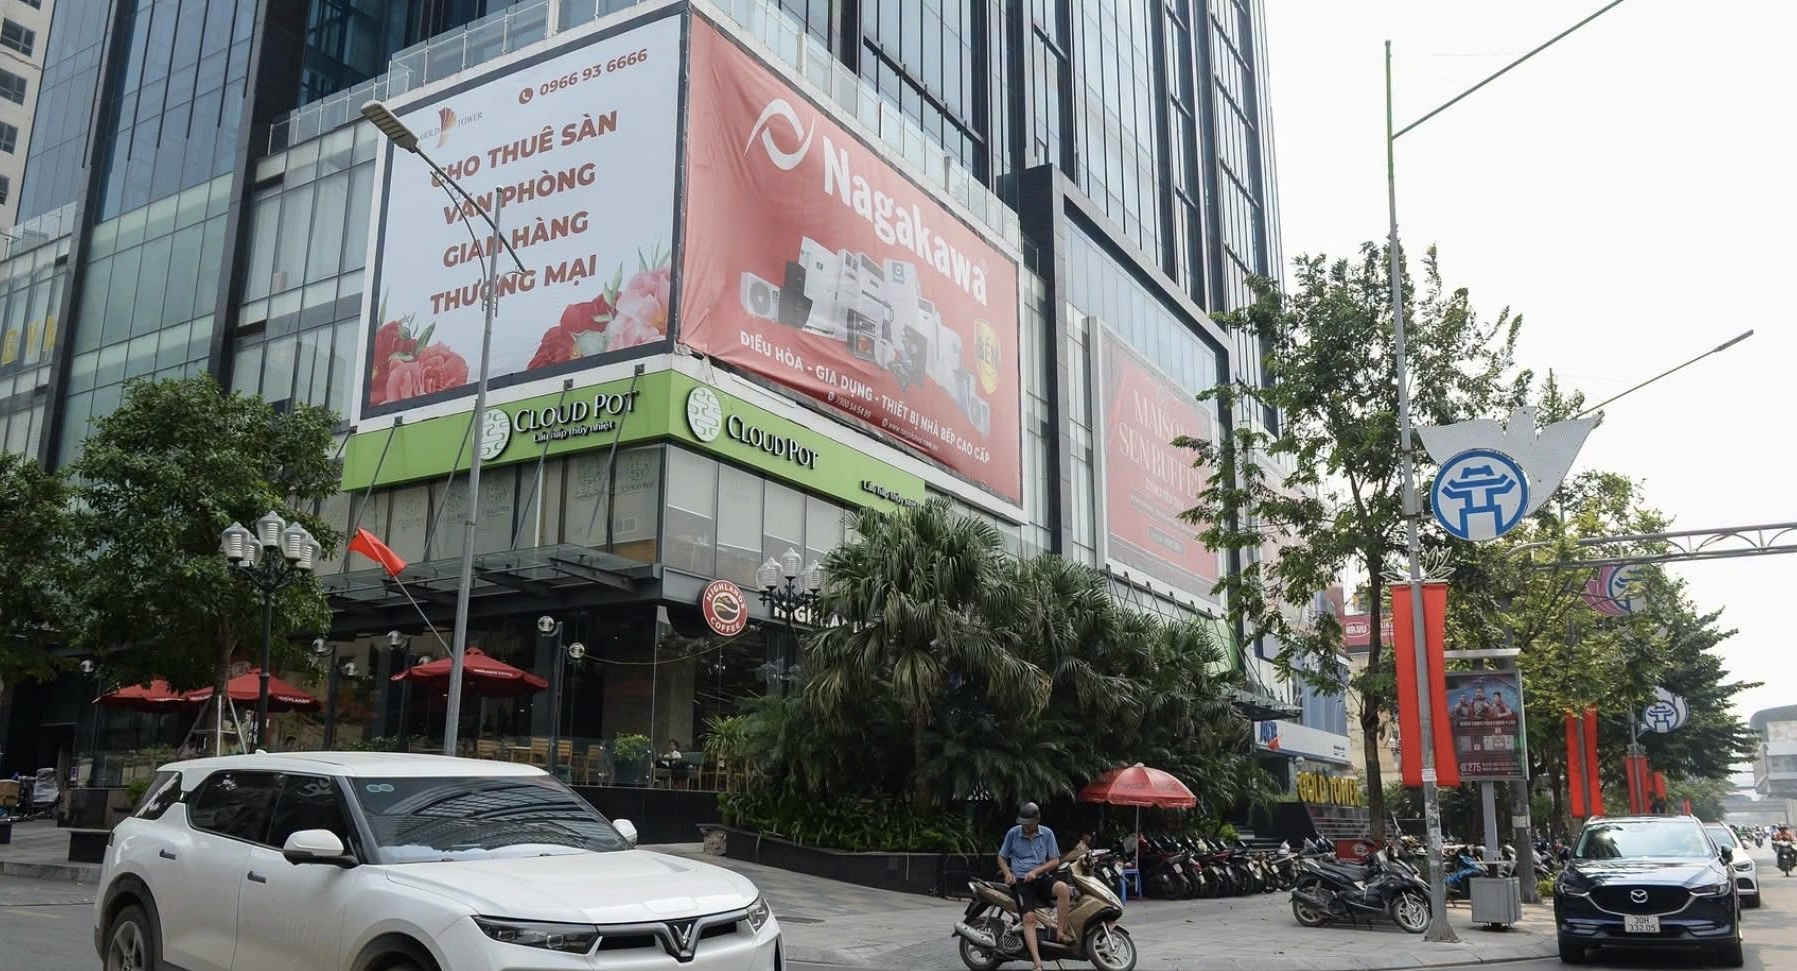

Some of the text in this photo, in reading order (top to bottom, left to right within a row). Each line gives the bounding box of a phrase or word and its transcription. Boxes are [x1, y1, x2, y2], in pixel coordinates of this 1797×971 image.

[540, 49, 648, 96] 0966 93 6666
[458, 111, 483, 128] TOWER
[431, 110, 618, 188] CHO THUÊ SÀN
[500, 163, 597, 208] PHÒNG
[512, 210, 589, 250] HÀNG
[823, 135, 987, 306] Nagakawa
[544, 254, 597, 287] MẠI
[513, 391, 640, 433] CLOUD POT
[775, 346, 804, 372] HÒA
[816, 365, 838, 386] GIA
[840, 375, 873, 401] DỤNG
[910, 411, 919, 430] BỊ
[920, 415, 939, 437] NHÀ
[957, 437, 973, 455] CAO
[727, 414, 818, 470] CLOUD POT
[1118, 422, 1150, 470] SEN
[706, 582, 746, 609] HIGHLANDS
[710, 616, 741, 632] COFFEE
[1297, 771, 1328, 804] GOLD
